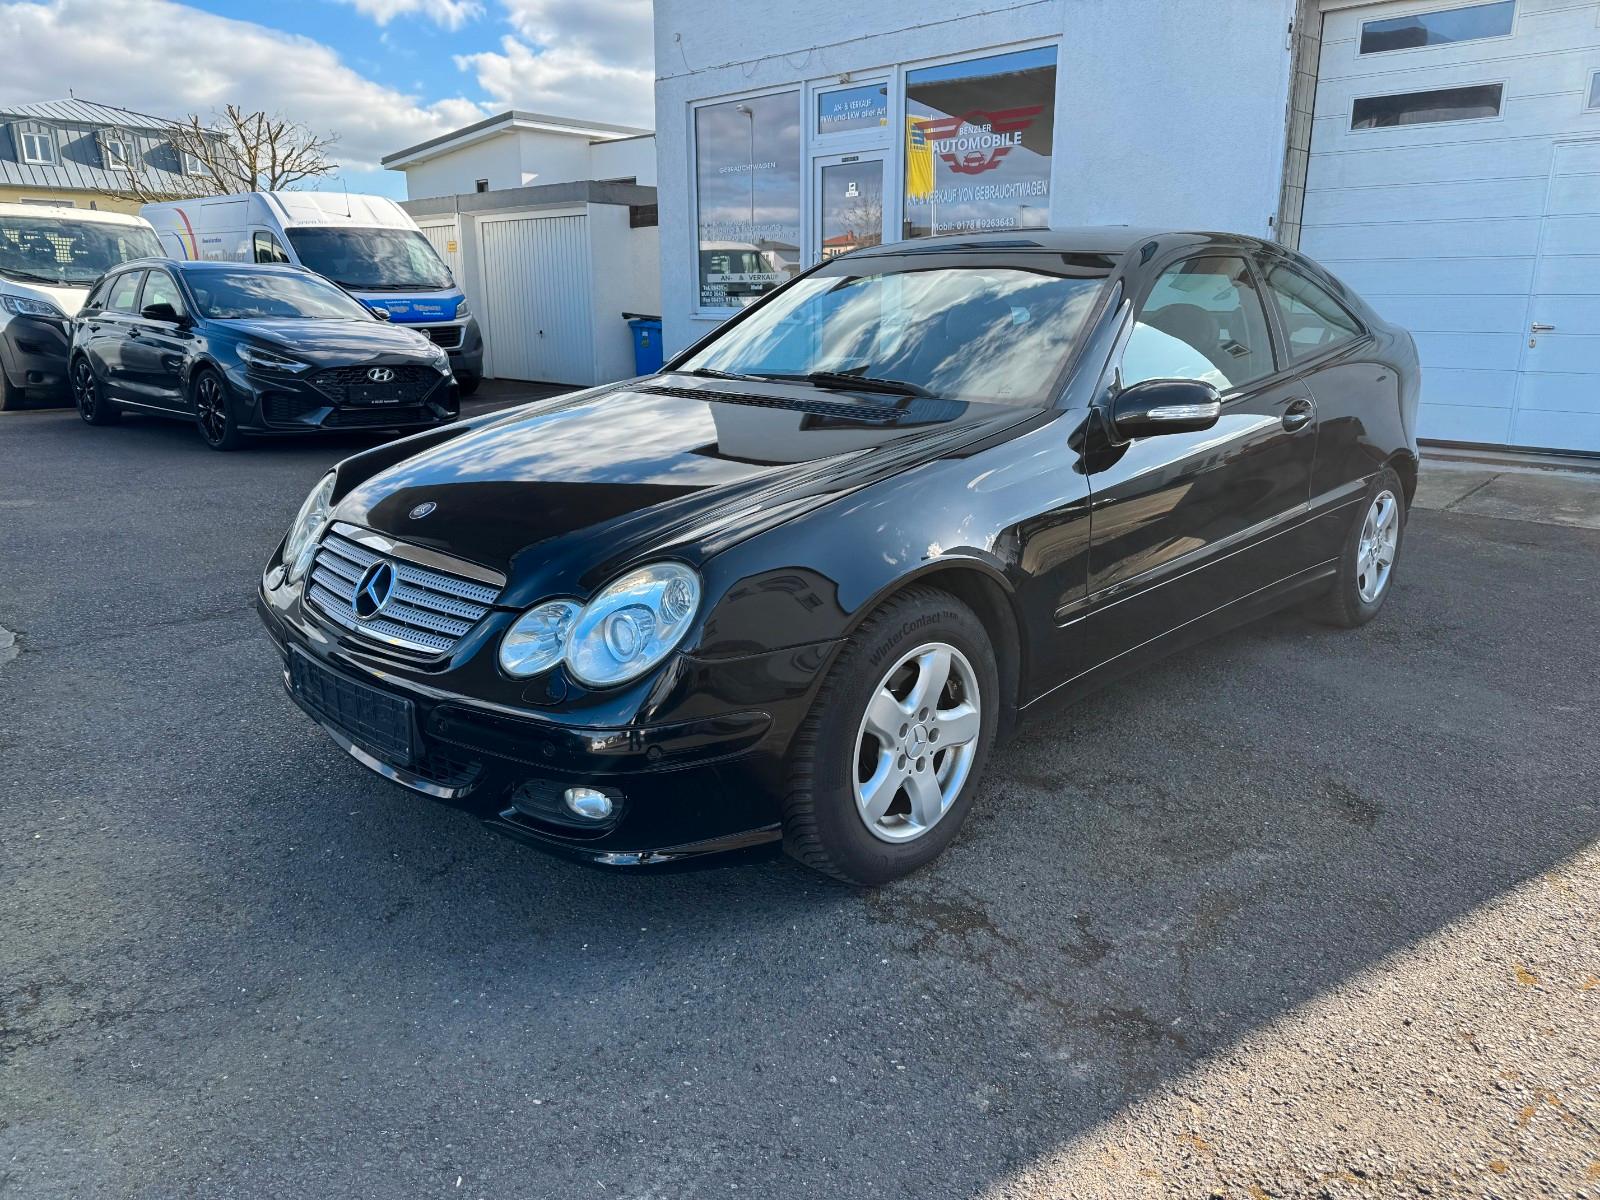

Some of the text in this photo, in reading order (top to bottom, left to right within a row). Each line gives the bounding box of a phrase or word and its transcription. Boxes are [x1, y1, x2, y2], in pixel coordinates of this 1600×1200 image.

[850, 98, 872, 109] VERKAUF
[960, 123, 992, 135] BENZLER
[933, 131, 1022, 153] AUTOMOBILE
[719, 161, 776, 174] GEBRAUCHTWAGEN
[958, 186, 973, 201] VON
[975, 180, 1048, 200] GEBRAUCHTWAGEN
[870, 611, 940, 666] WinterContact
